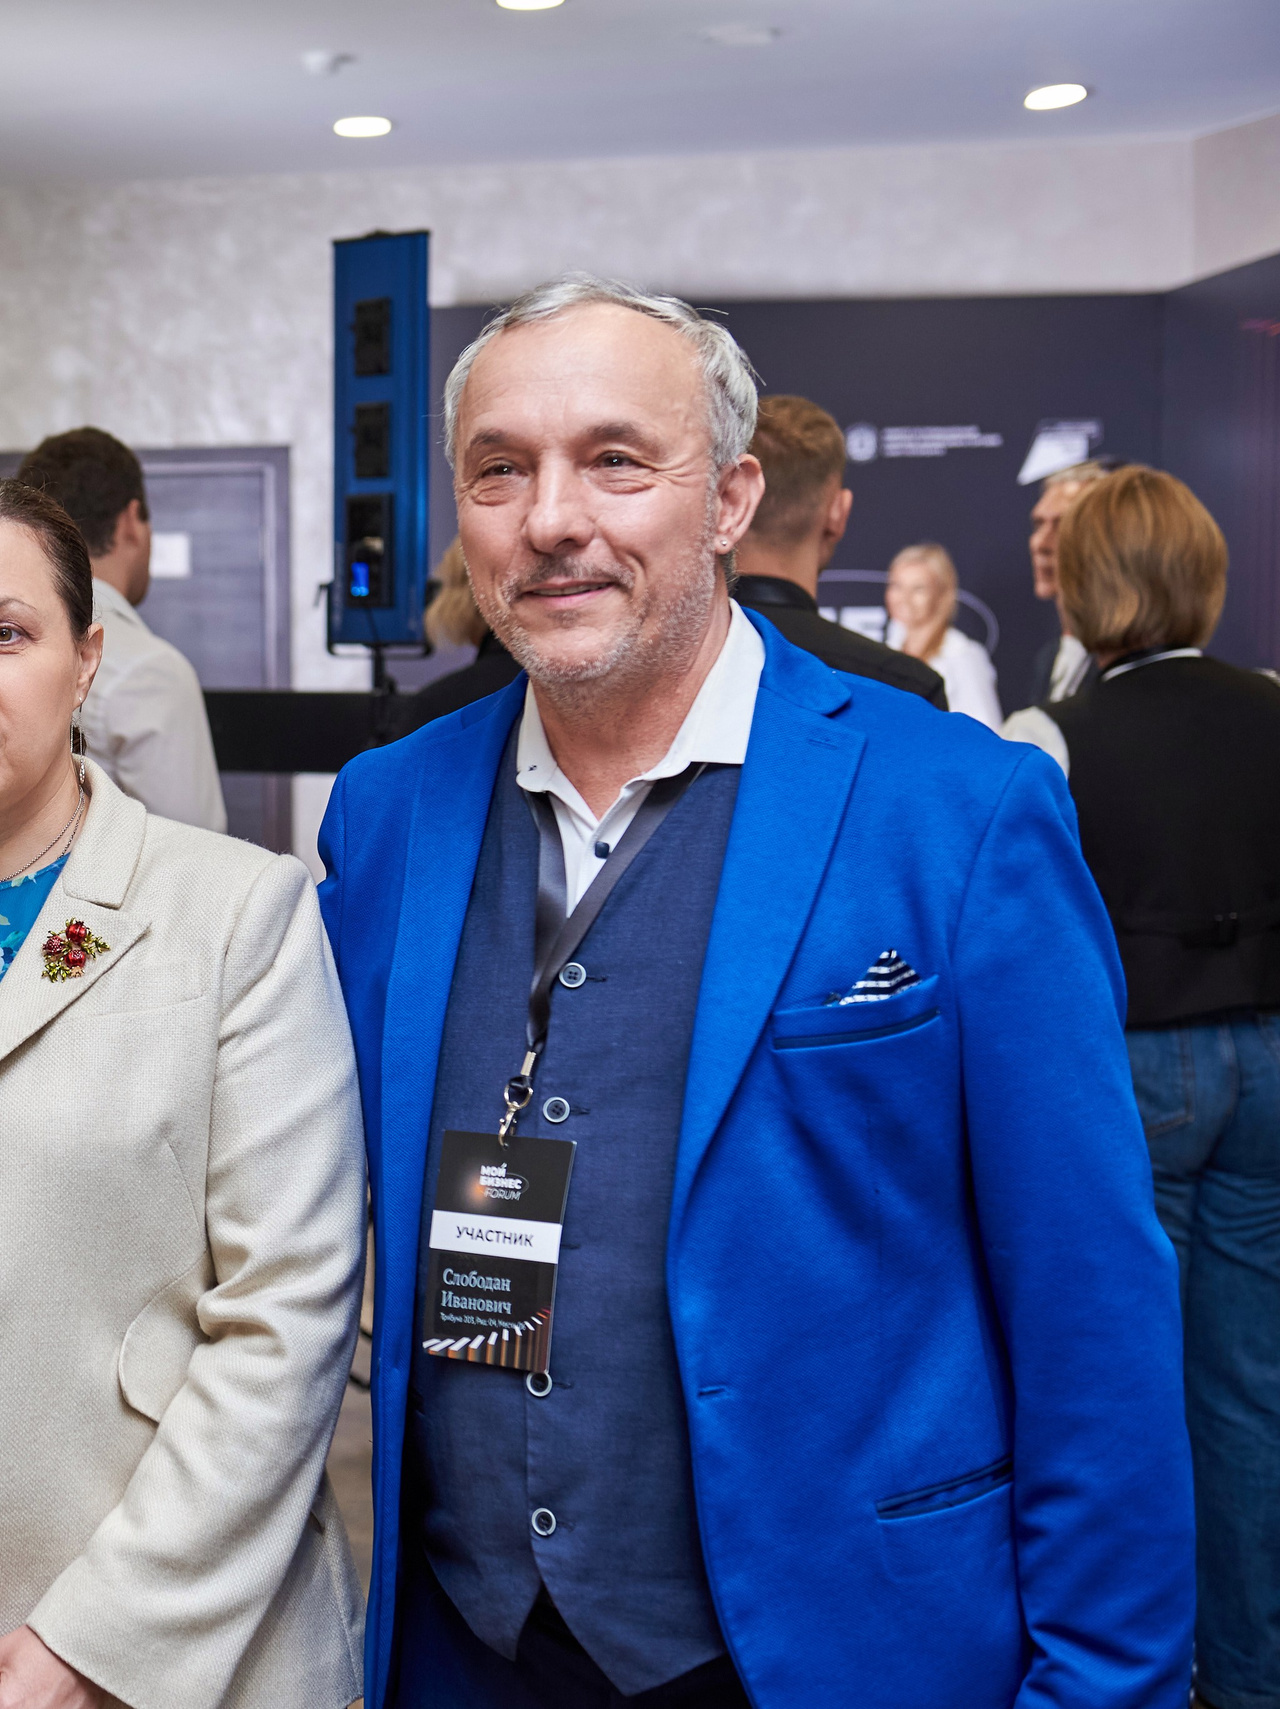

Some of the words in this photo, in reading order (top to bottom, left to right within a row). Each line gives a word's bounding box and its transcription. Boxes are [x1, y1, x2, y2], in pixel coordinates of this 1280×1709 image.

[480, 1162, 508, 1178] МОЙ
[479, 1176, 523, 1190] БИЗНЕС
[484, 1187, 522, 1201] FORUM
[456, 1225, 535, 1248] УЧАСТНИК
[442, 1267, 512, 1293] Слободан
[440, 1290, 512, 1315] Иванович
